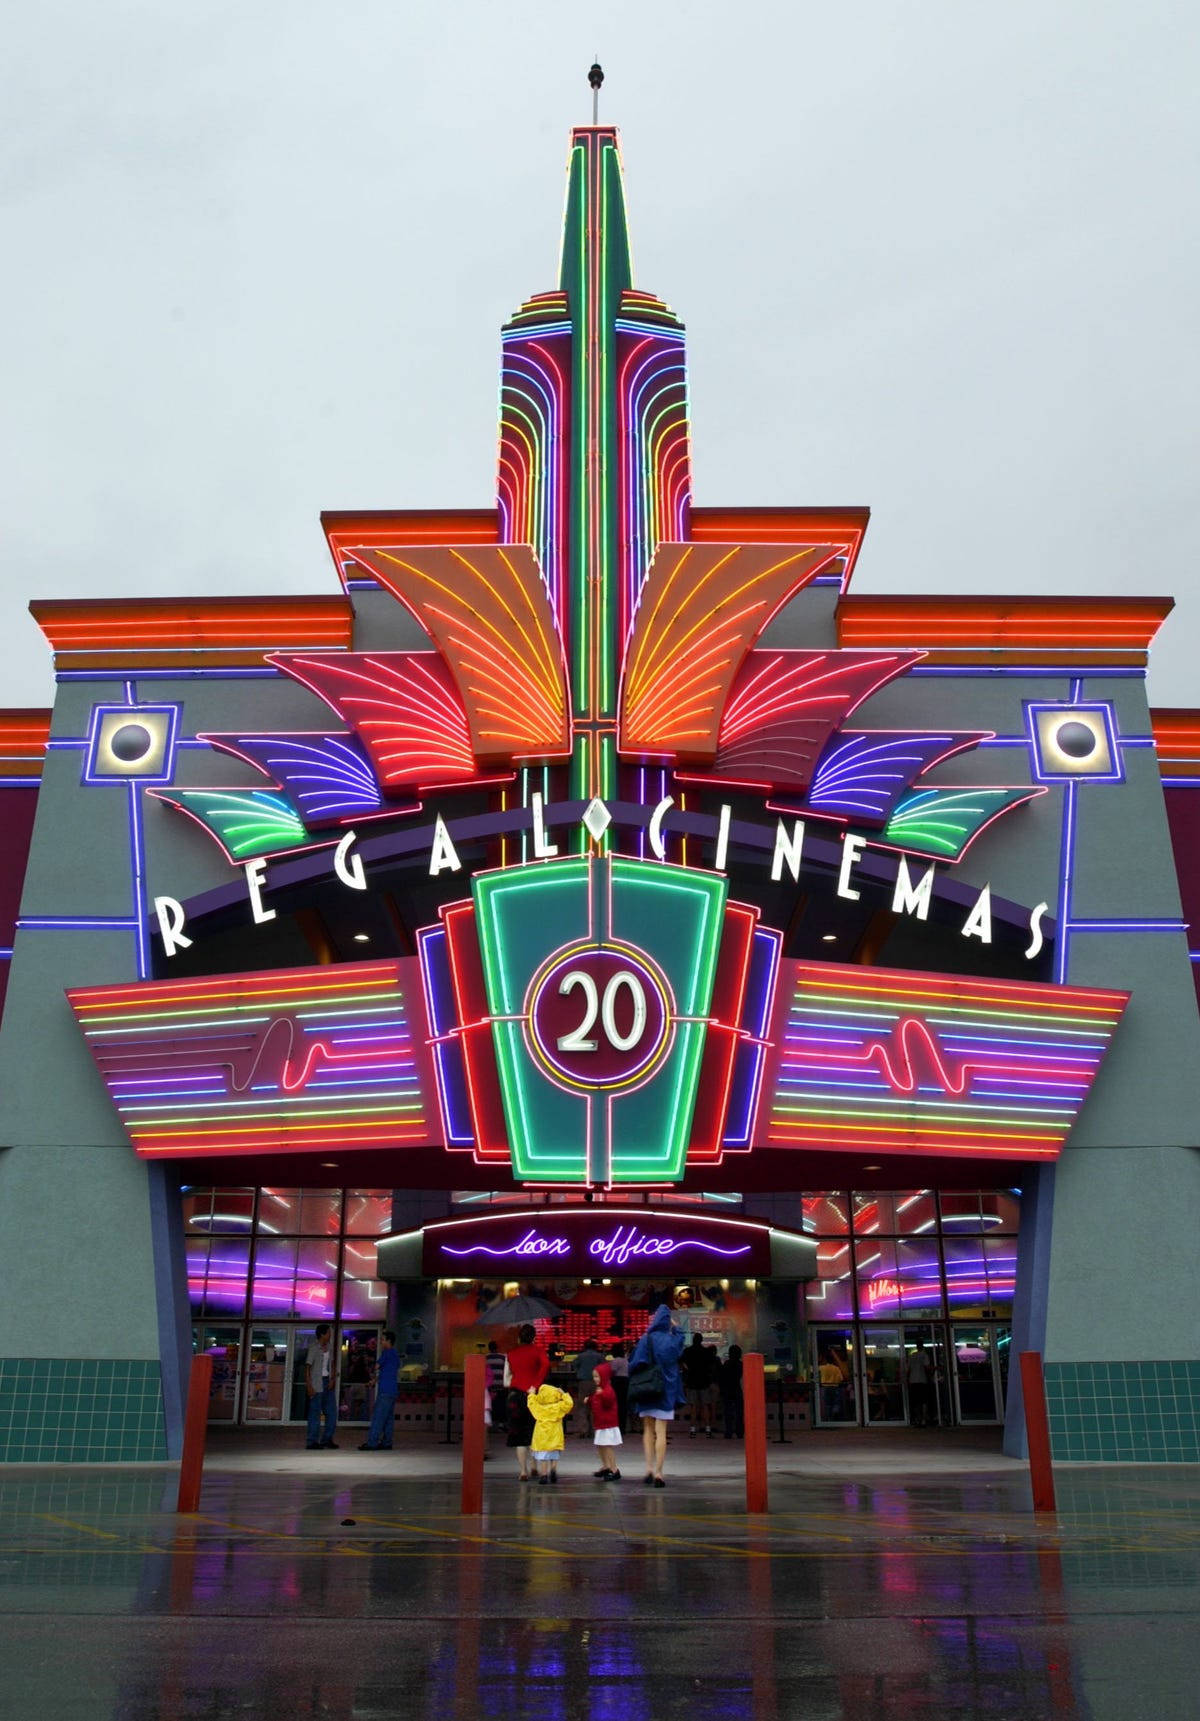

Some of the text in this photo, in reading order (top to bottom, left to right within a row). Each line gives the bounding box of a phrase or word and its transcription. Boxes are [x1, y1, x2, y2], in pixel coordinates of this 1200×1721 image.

[154, 793, 1048, 961] REGAL CINEMAS
[557, 971, 646, 1051] 20
[515, 1226, 674, 1263] box office
